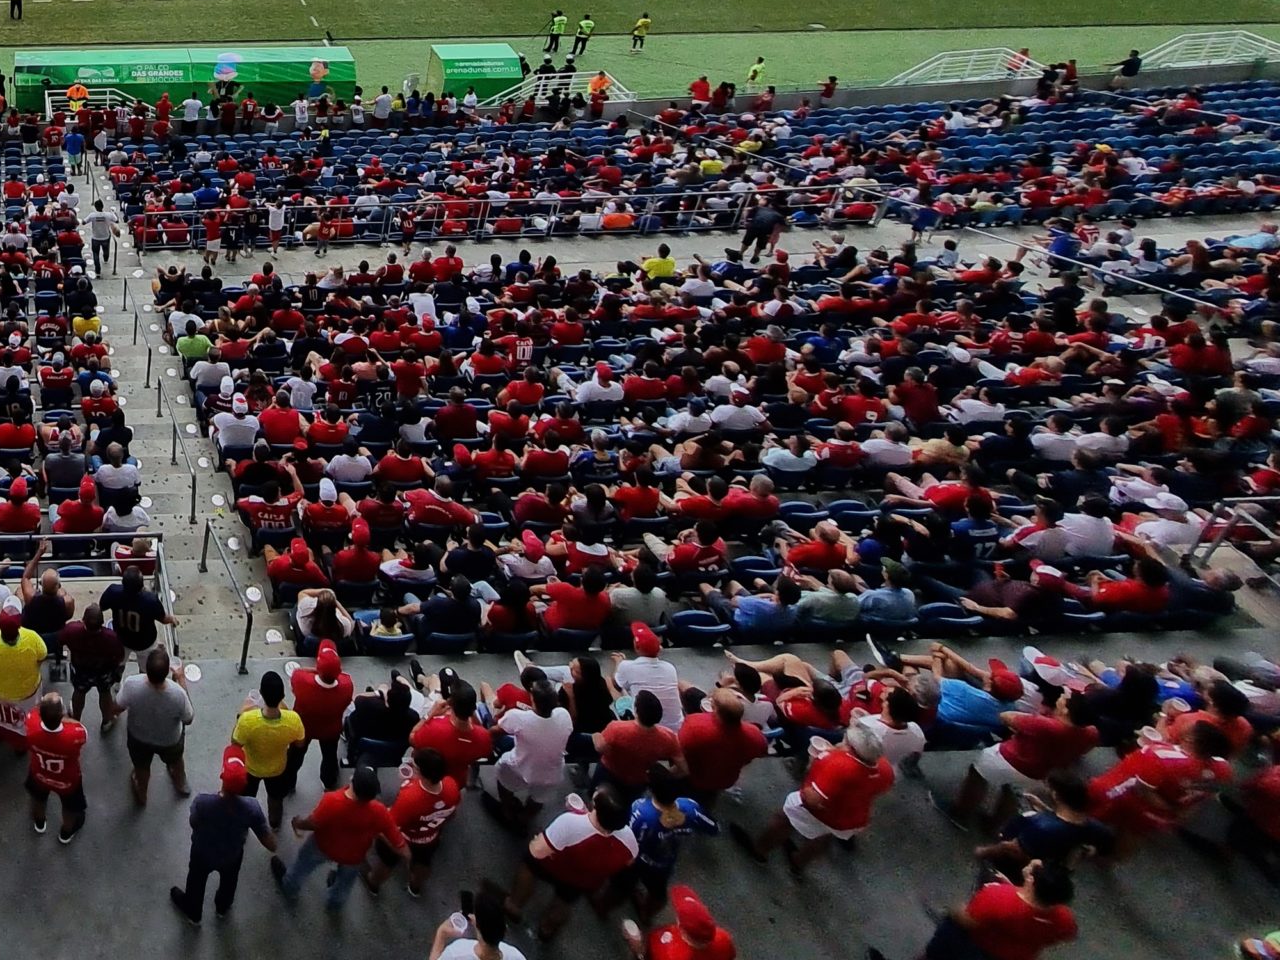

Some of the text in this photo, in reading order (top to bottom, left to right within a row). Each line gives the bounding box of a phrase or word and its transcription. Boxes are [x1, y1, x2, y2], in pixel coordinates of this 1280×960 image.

[118, 173, 127, 181] 10
[230, 231, 235, 240] 4
[309, 289, 317, 301] 10
[339, 392, 347, 400] 10
[866, 412, 876, 423] 9
[258, 513, 284, 521] CAIXA
[975, 542, 995, 557] 17
[120, 612, 141, 633] 10
[36, 753, 64, 774] 10
